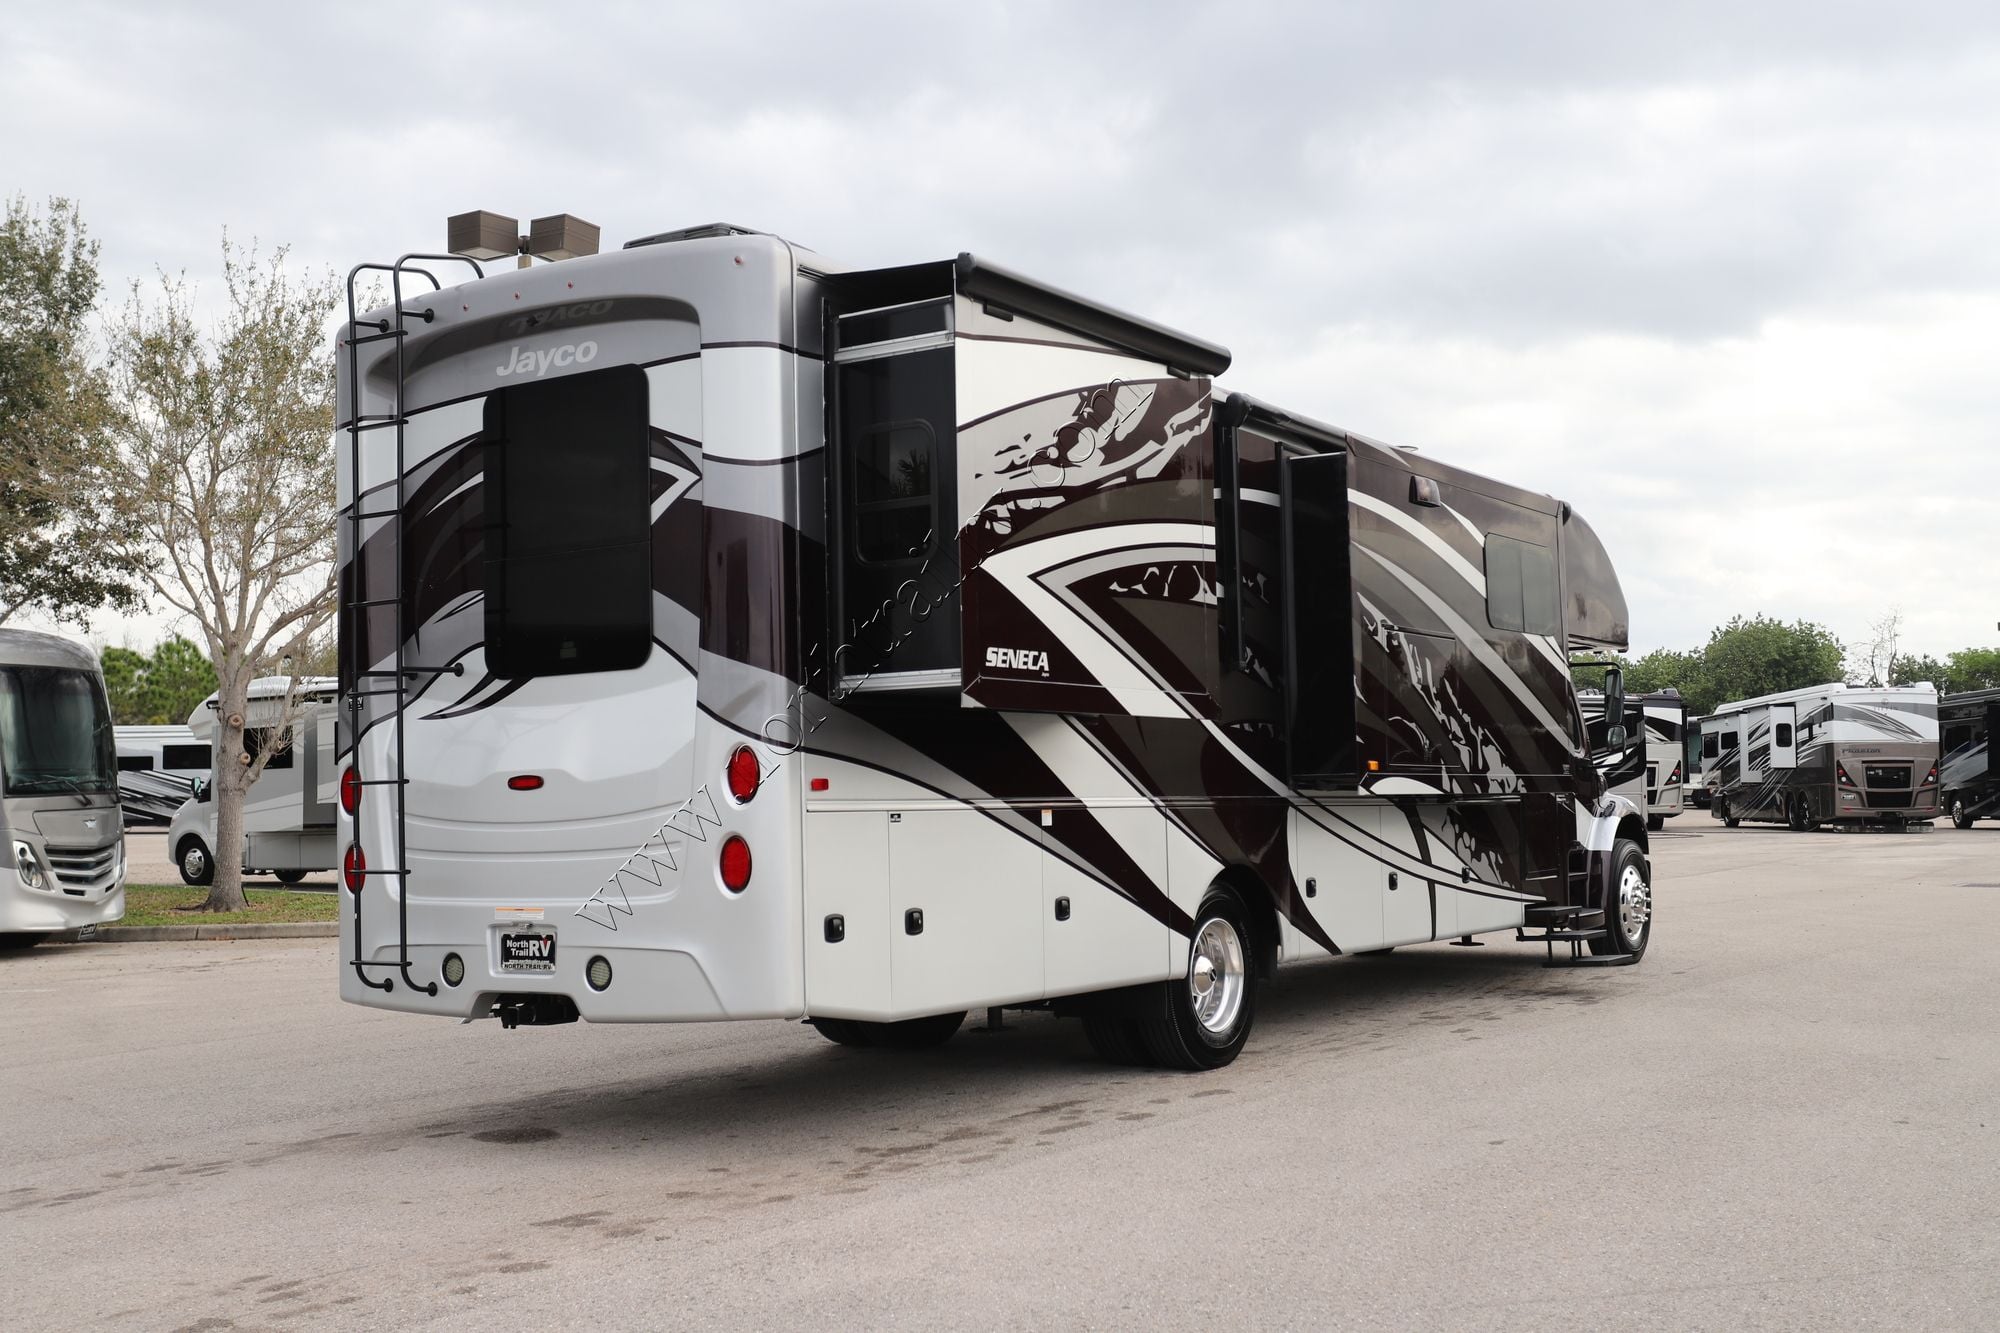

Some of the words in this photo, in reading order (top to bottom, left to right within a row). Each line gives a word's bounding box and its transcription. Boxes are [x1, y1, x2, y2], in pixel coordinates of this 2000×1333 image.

[496, 340, 598, 377] Jayco
[985, 646, 1050, 672] SENECA
[506, 939, 529, 948] North
[528, 940, 552, 957] RV
[510, 948, 529, 957] Trail
